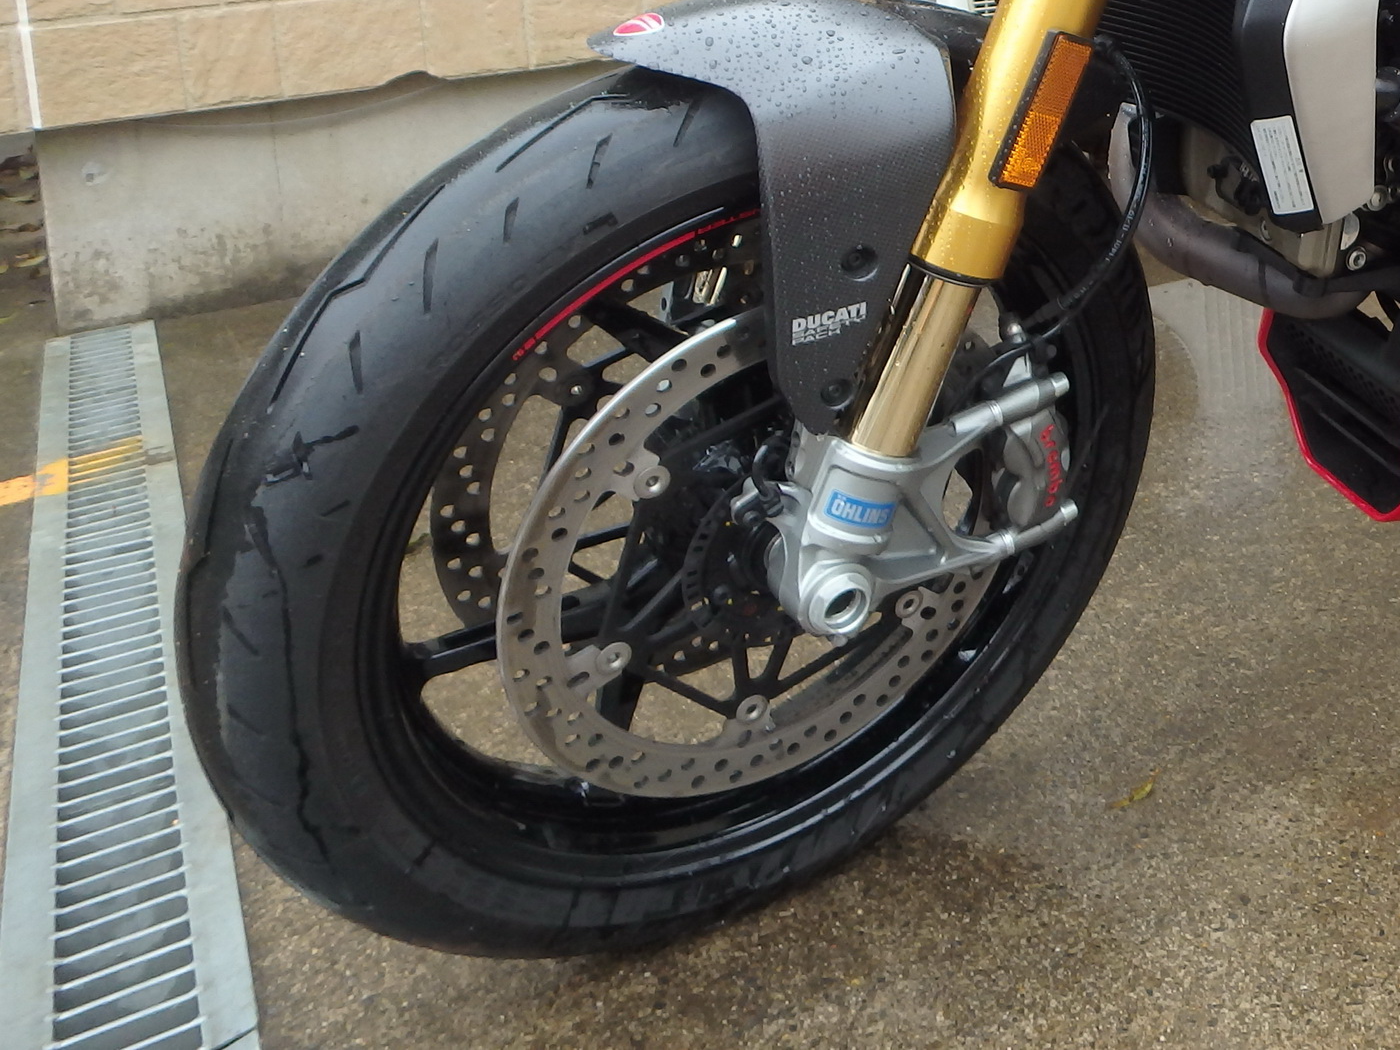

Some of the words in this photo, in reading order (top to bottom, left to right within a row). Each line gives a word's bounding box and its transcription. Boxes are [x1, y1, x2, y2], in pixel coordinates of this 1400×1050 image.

[792, 301, 867, 332] DUCATI
[1040, 424, 1063, 507] brembo
[831, 494, 889, 524] ÖHLINS
